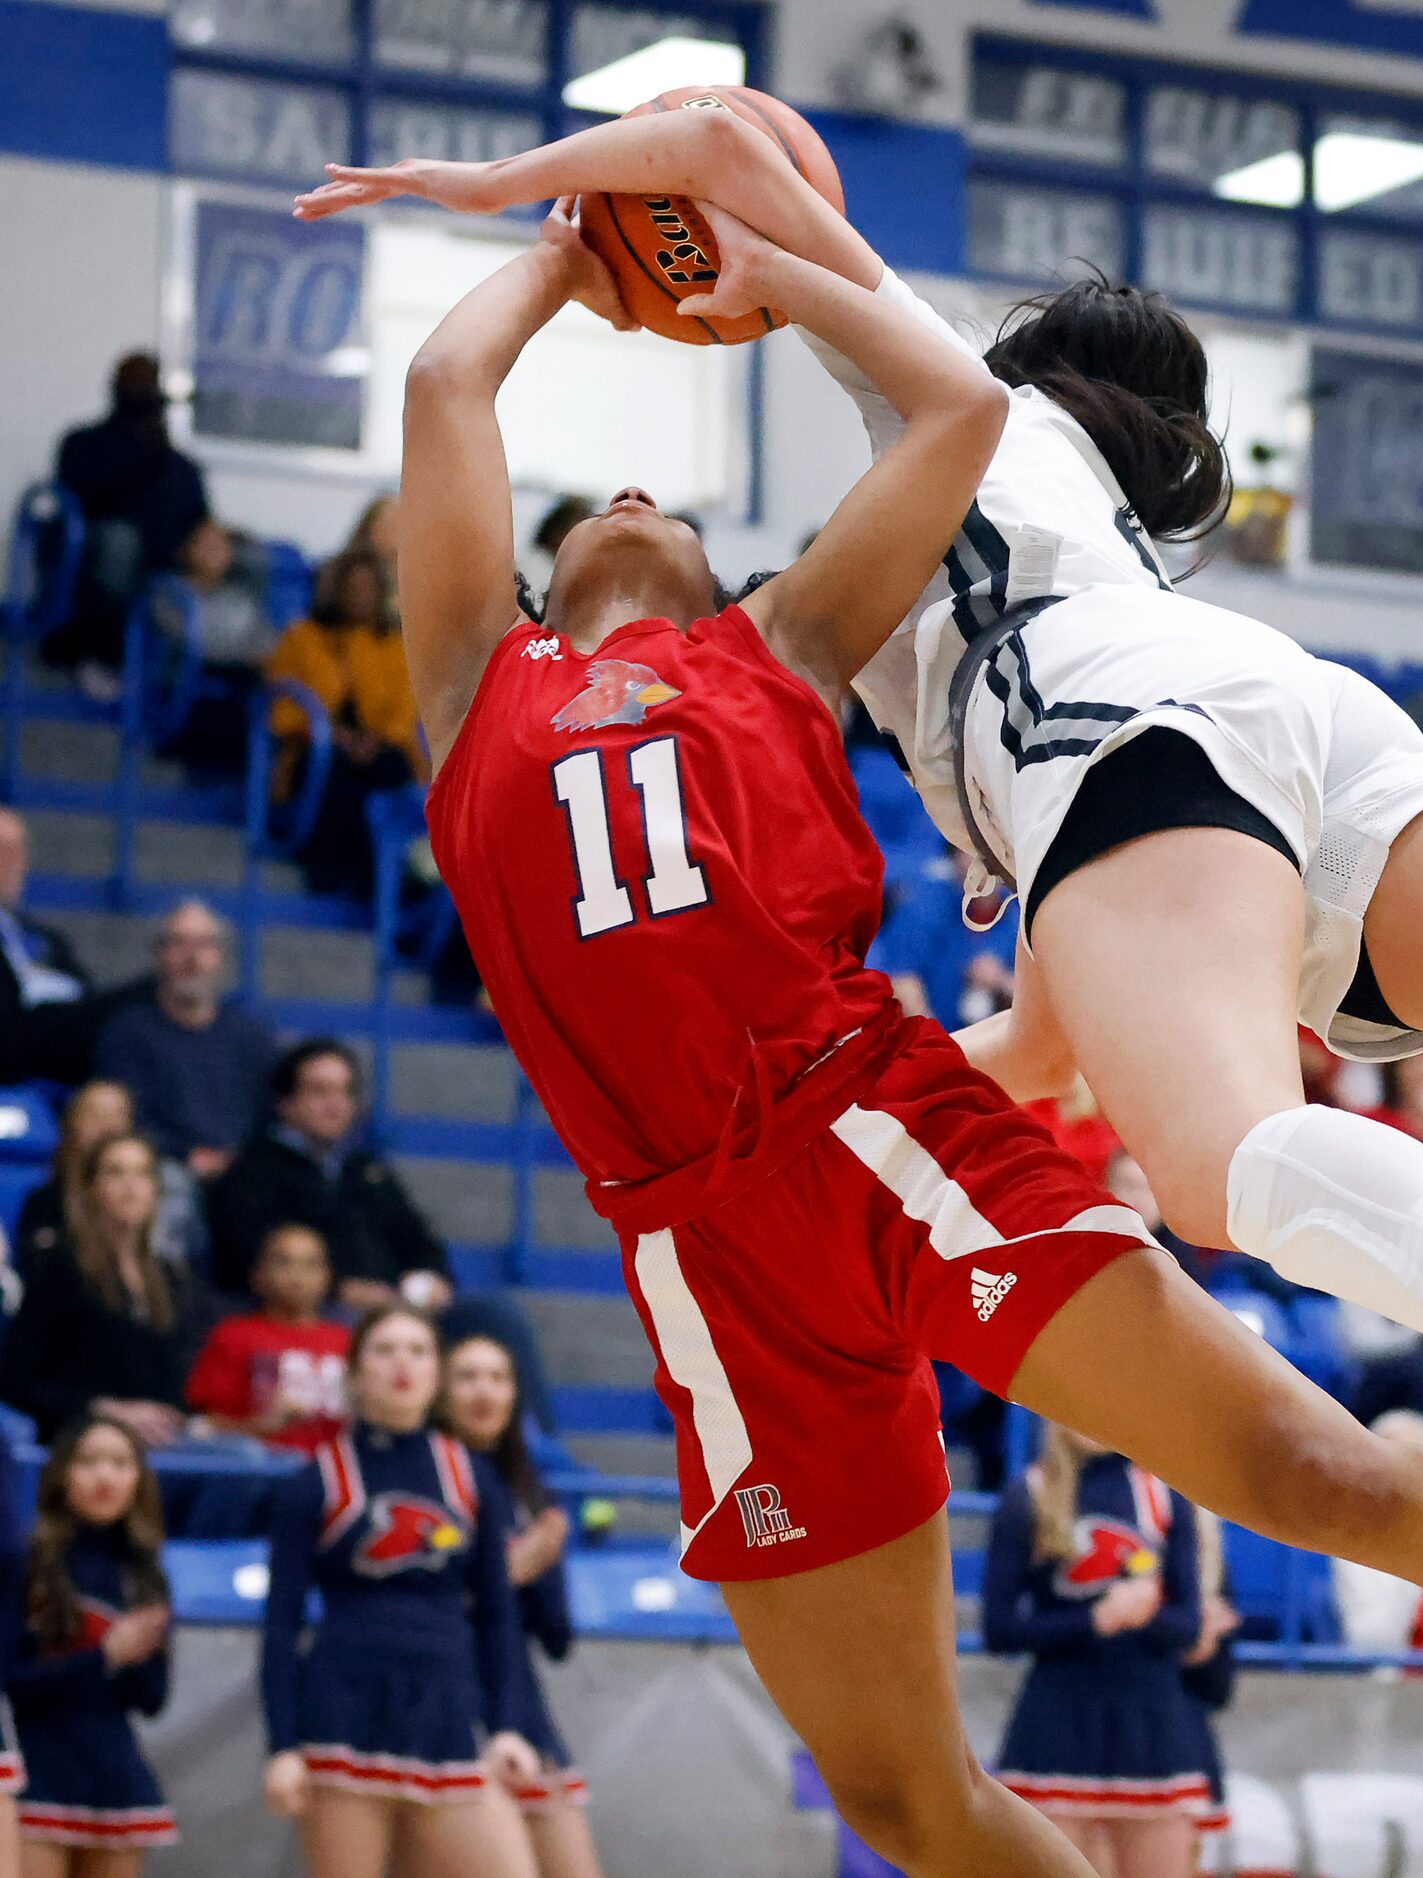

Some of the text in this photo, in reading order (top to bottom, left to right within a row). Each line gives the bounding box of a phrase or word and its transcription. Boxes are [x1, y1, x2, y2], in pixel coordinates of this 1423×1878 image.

[550, 735, 712, 941] 11
[977, 1271, 1018, 1322] adidas
[756, 1526, 807, 1547] LADY CARDS
